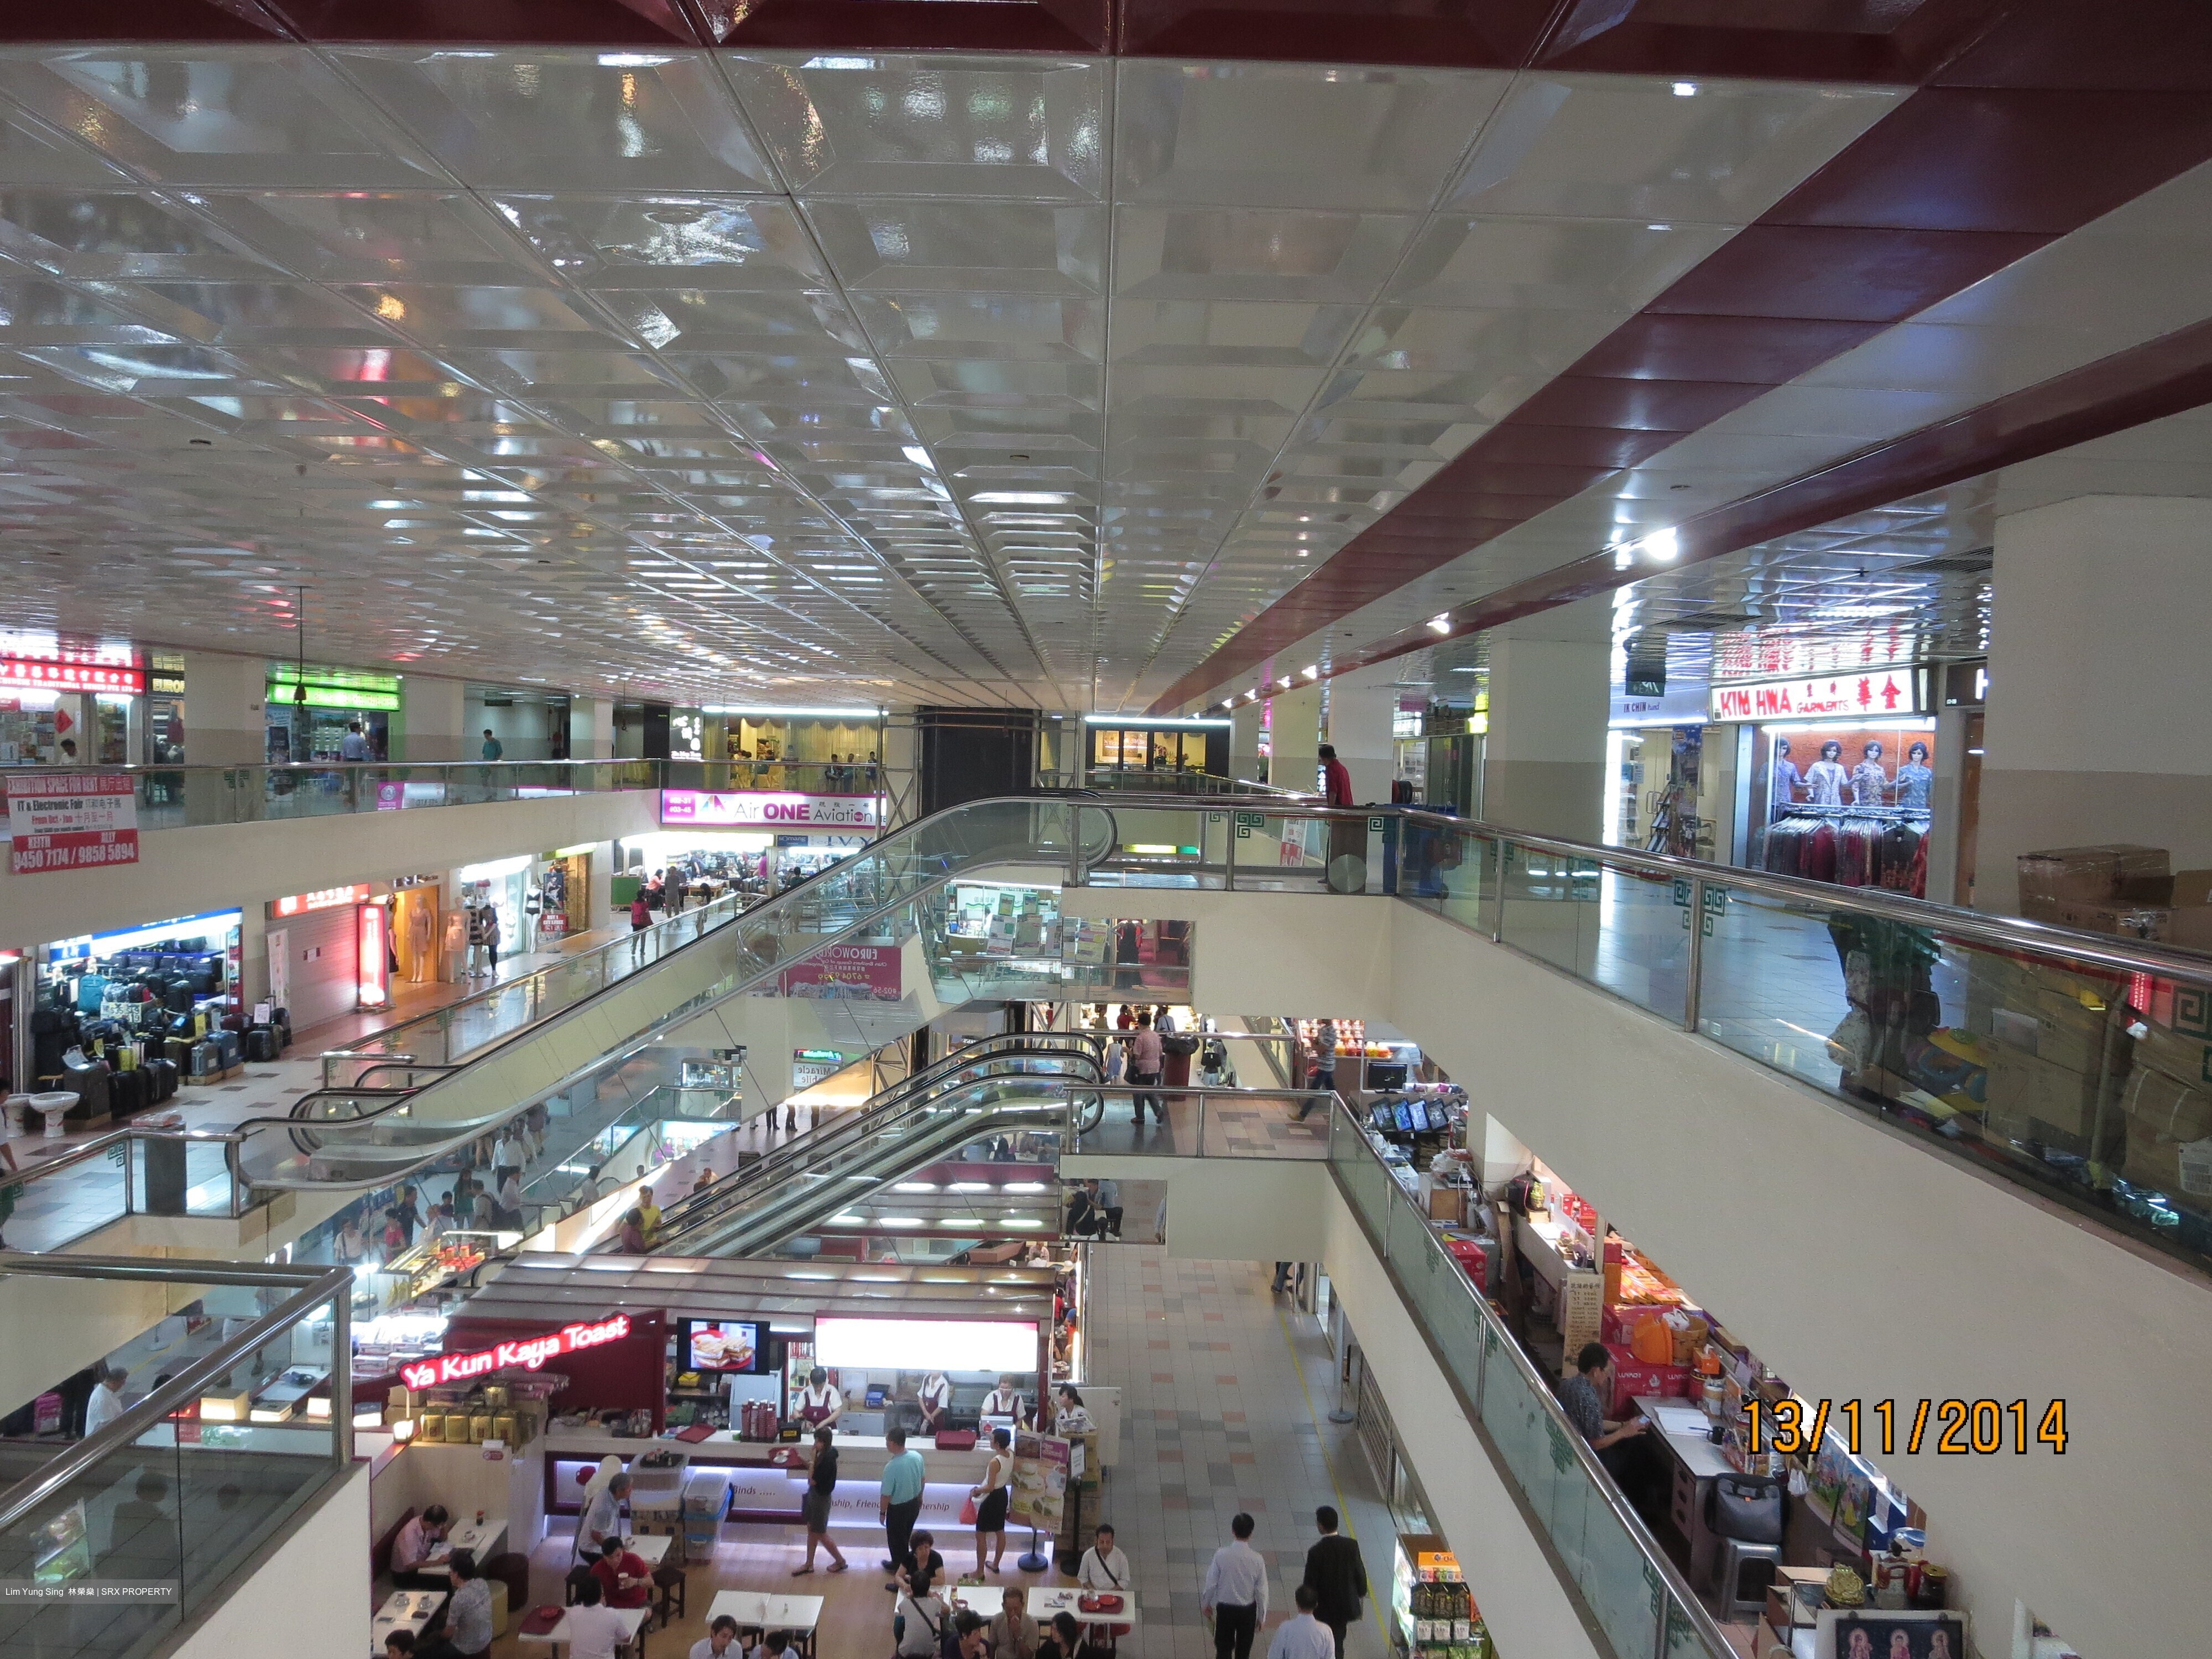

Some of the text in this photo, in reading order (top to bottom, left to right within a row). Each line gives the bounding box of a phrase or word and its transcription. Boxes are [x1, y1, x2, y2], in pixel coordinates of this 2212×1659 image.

[1720, 690, 1751, 718] KIM
[1756, 687, 1792, 716] HWA
[1797, 699, 1850, 714] GARMENTS
[17, 800, 25, 812] IT
[33, 799, 69, 811] Electronic
[70, 798, 83, 810] Fair
[734, 803, 759, 820] Air
[763, 803, 810, 821] ONE
[813, 808, 873, 823] Aviation
[14, 851, 44, 870] 9450
[46, 847, 69, 867] 7174
[79, 846, 106, 864] 9858
[107, 843, 135, 859] 5894
[404, 1316, 627, 1389] Ya Kun Kaya Toast
[733, 1485, 756, 1495] Binds
